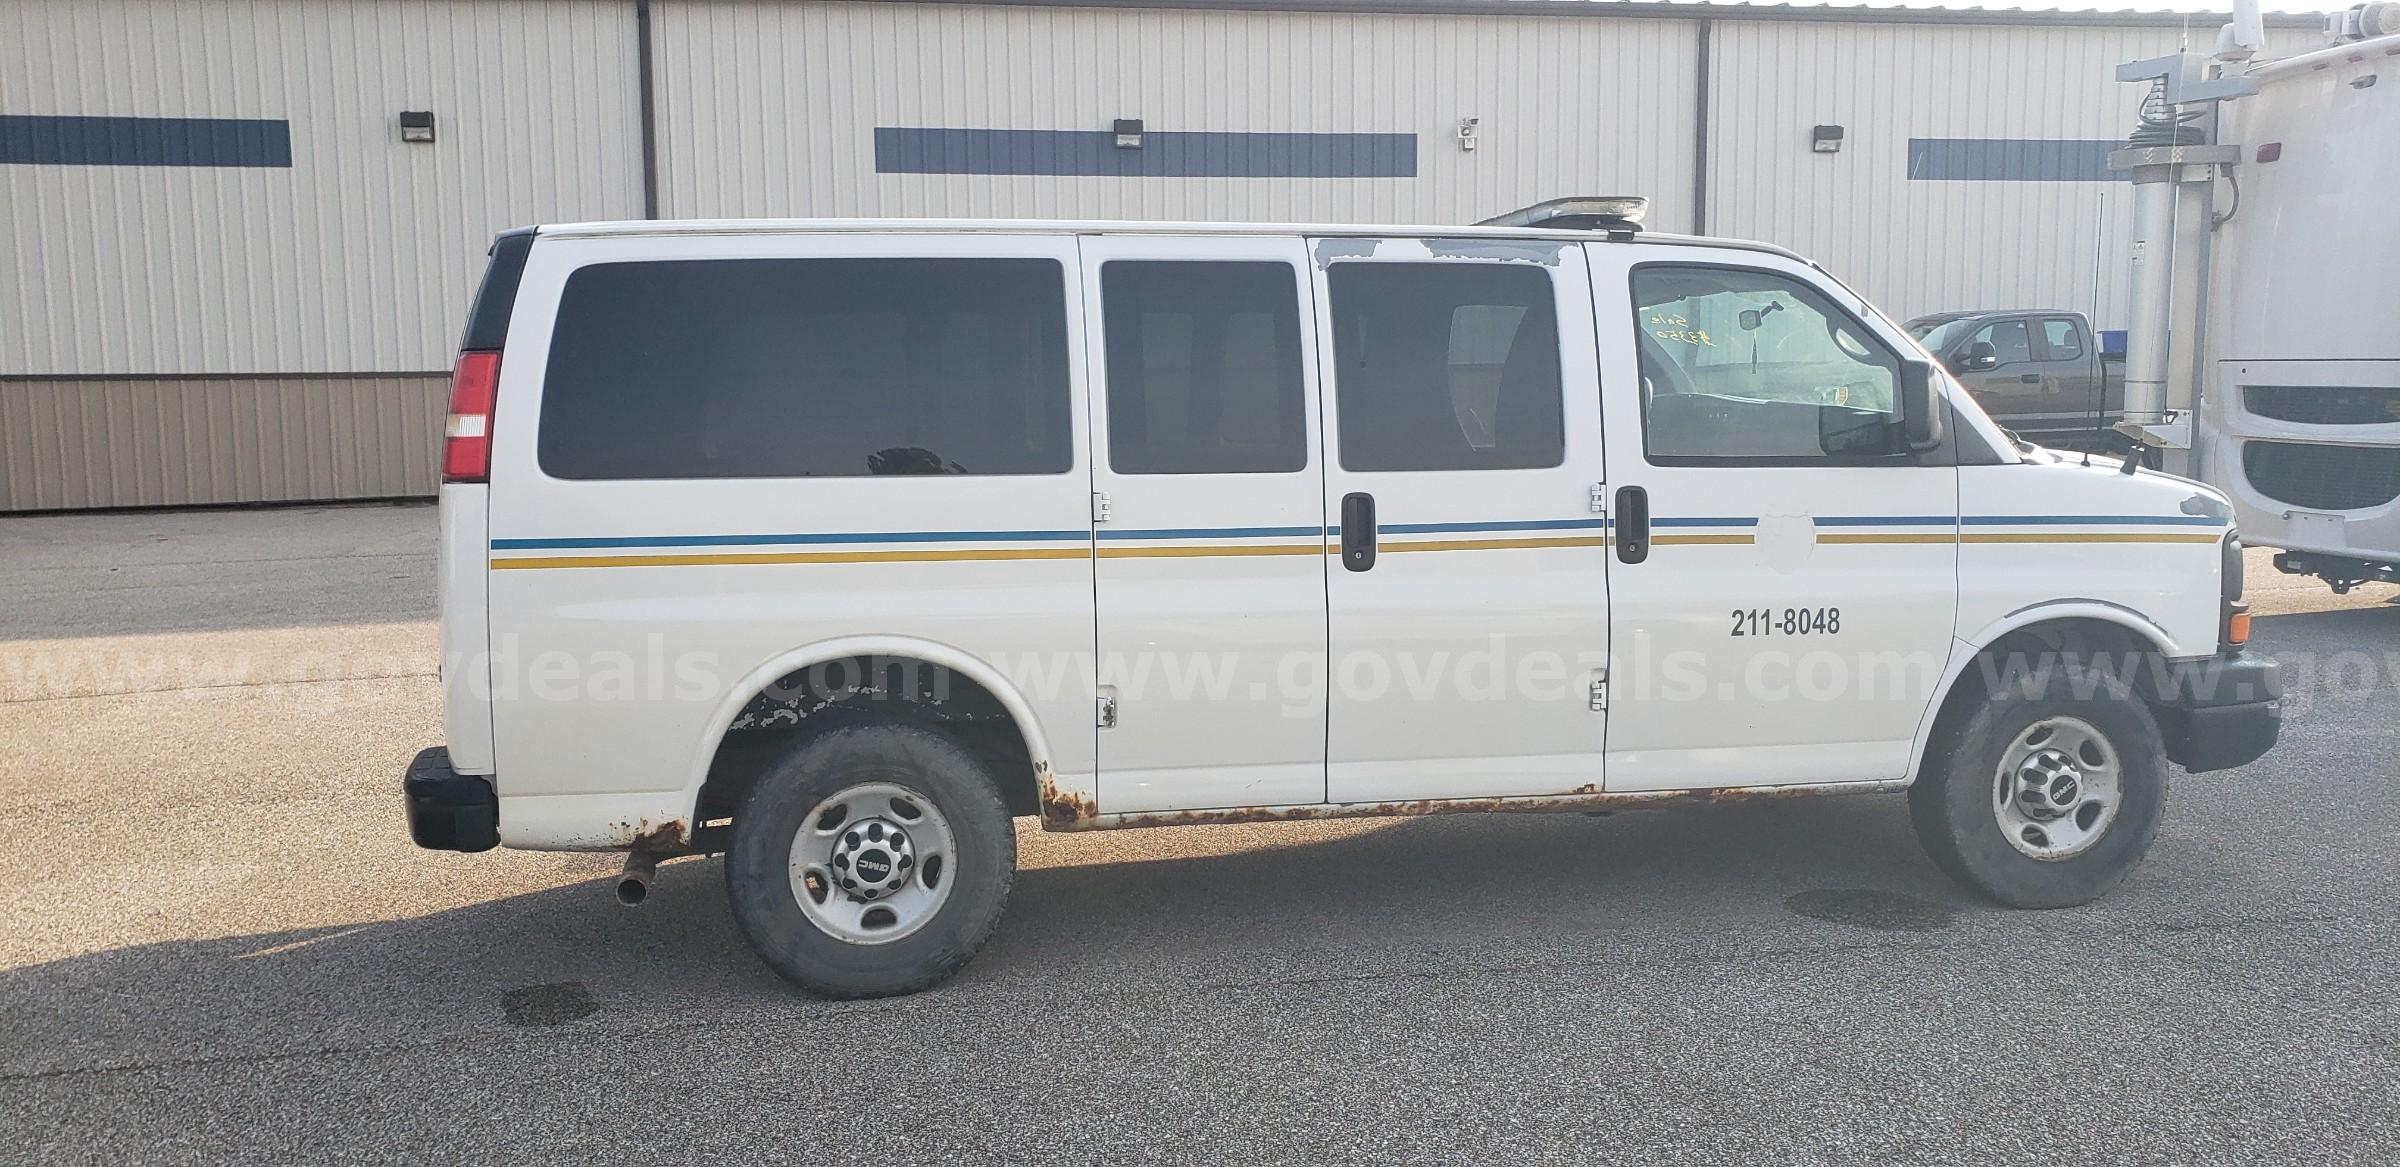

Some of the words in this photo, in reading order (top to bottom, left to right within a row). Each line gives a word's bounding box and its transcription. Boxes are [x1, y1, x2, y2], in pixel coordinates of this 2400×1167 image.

[1731, 607, 1840, 636] 211-8048
[2052, 780, 2076, 801] GMC
[858, 859, 890, 872] GMC
